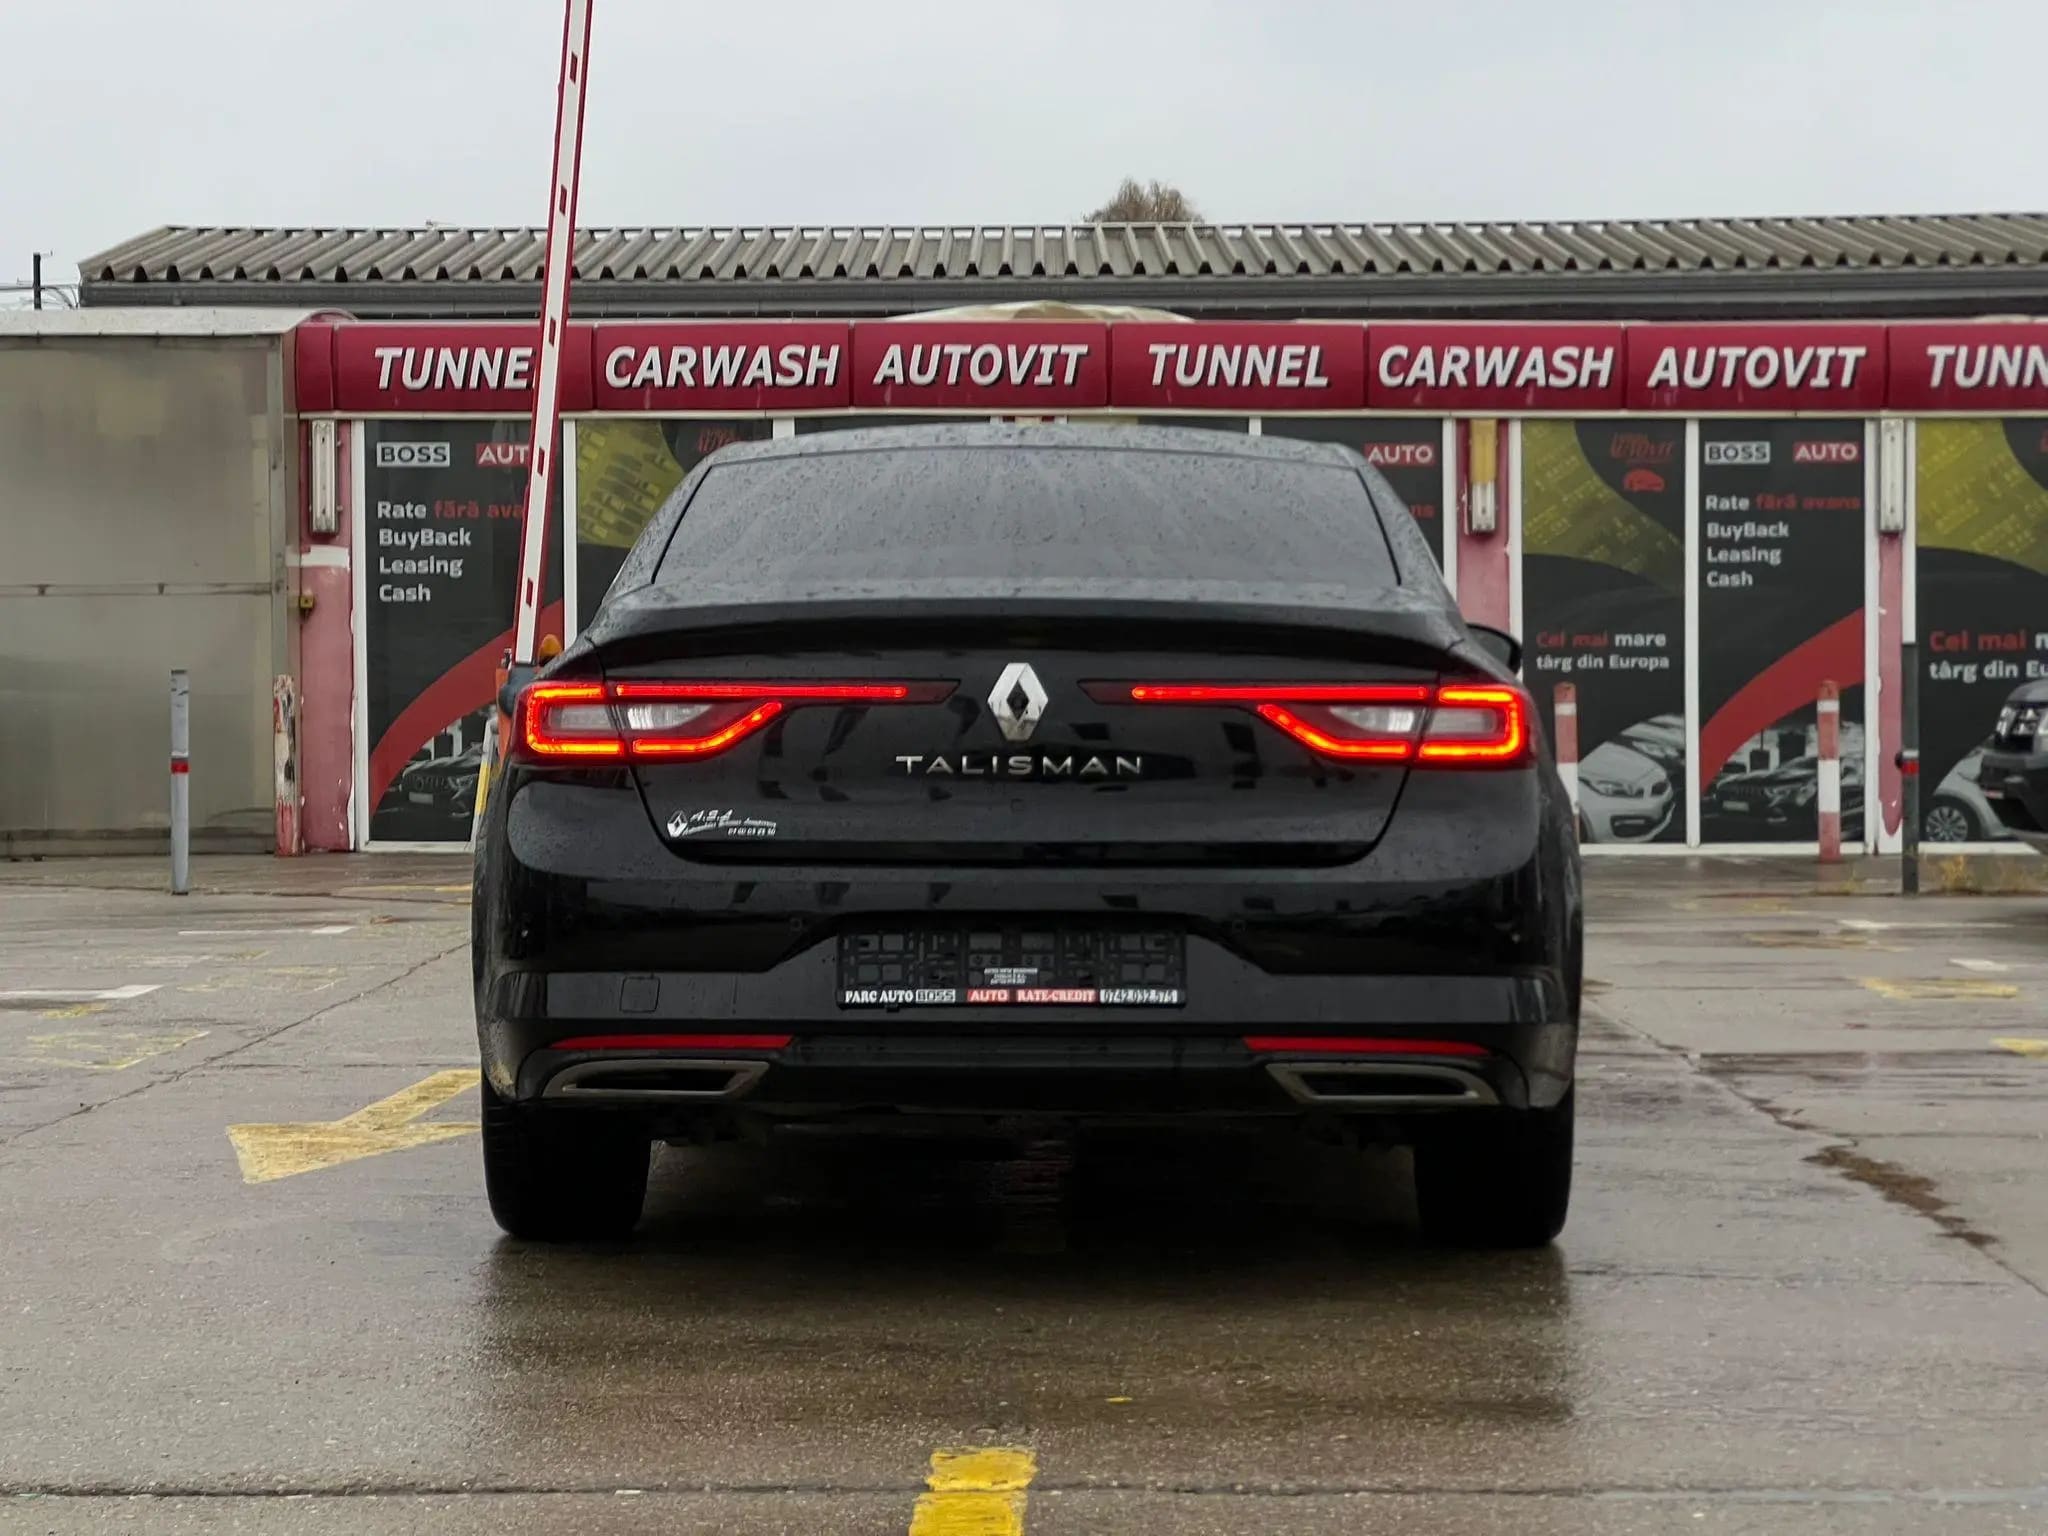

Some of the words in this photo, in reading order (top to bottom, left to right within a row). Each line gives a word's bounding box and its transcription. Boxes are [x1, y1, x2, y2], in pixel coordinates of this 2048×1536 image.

[375, 347, 535, 390] TUNNE
[605, 344, 840, 388] CARWASH
[873, 343, 1090, 387] AUTOVIT
[1148, 343, 1329, 388] TUNNEL
[1378, 345, 1614, 389] CARWASH
[1647, 345, 1868, 389] AUTOVIT
[379, 445, 448, 464] BOSS
[478, 446, 529, 465] AUT
[1368, 444, 1433, 464] AUTO
[1708, 444, 1769, 462] BOSS
[1794, 443, 1858, 461] AUTO
[377, 500, 427, 519] Rate
[487, 504, 525, 519] ava
[1705, 494, 1750, 511] Rate
[379, 527, 472, 551] BuyBack
[1706, 521, 1790, 542] BuyBack
[1706, 545, 1782, 566] Leasing
[379, 555, 464, 579] Leasing
[1706, 570, 1753, 588] Cash
[379, 583, 431, 603] Cash
[1536, 630, 1566, 649] Cel
[1572, 630, 1608, 649] mai
[1614, 633, 1667, 648] mare
[1929, 631, 1970, 652] Cel
[1978, 630, 2027, 651] mai
[1536, 655, 1573, 673] târg
[1577, 654, 1604, 669] din
[1609, 655, 1670, 672] Europa
[1929, 660, 1977, 684] târg
[1983, 659, 2019, 678] din
[895, 755, 1143, 775] TALISMAN
[845, 989, 878, 1004] PARC
[878, 989, 914, 1004] AUTO
[917, 990, 956, 1003] BOSS
[970, 989, 1009, 1003] AUTO
